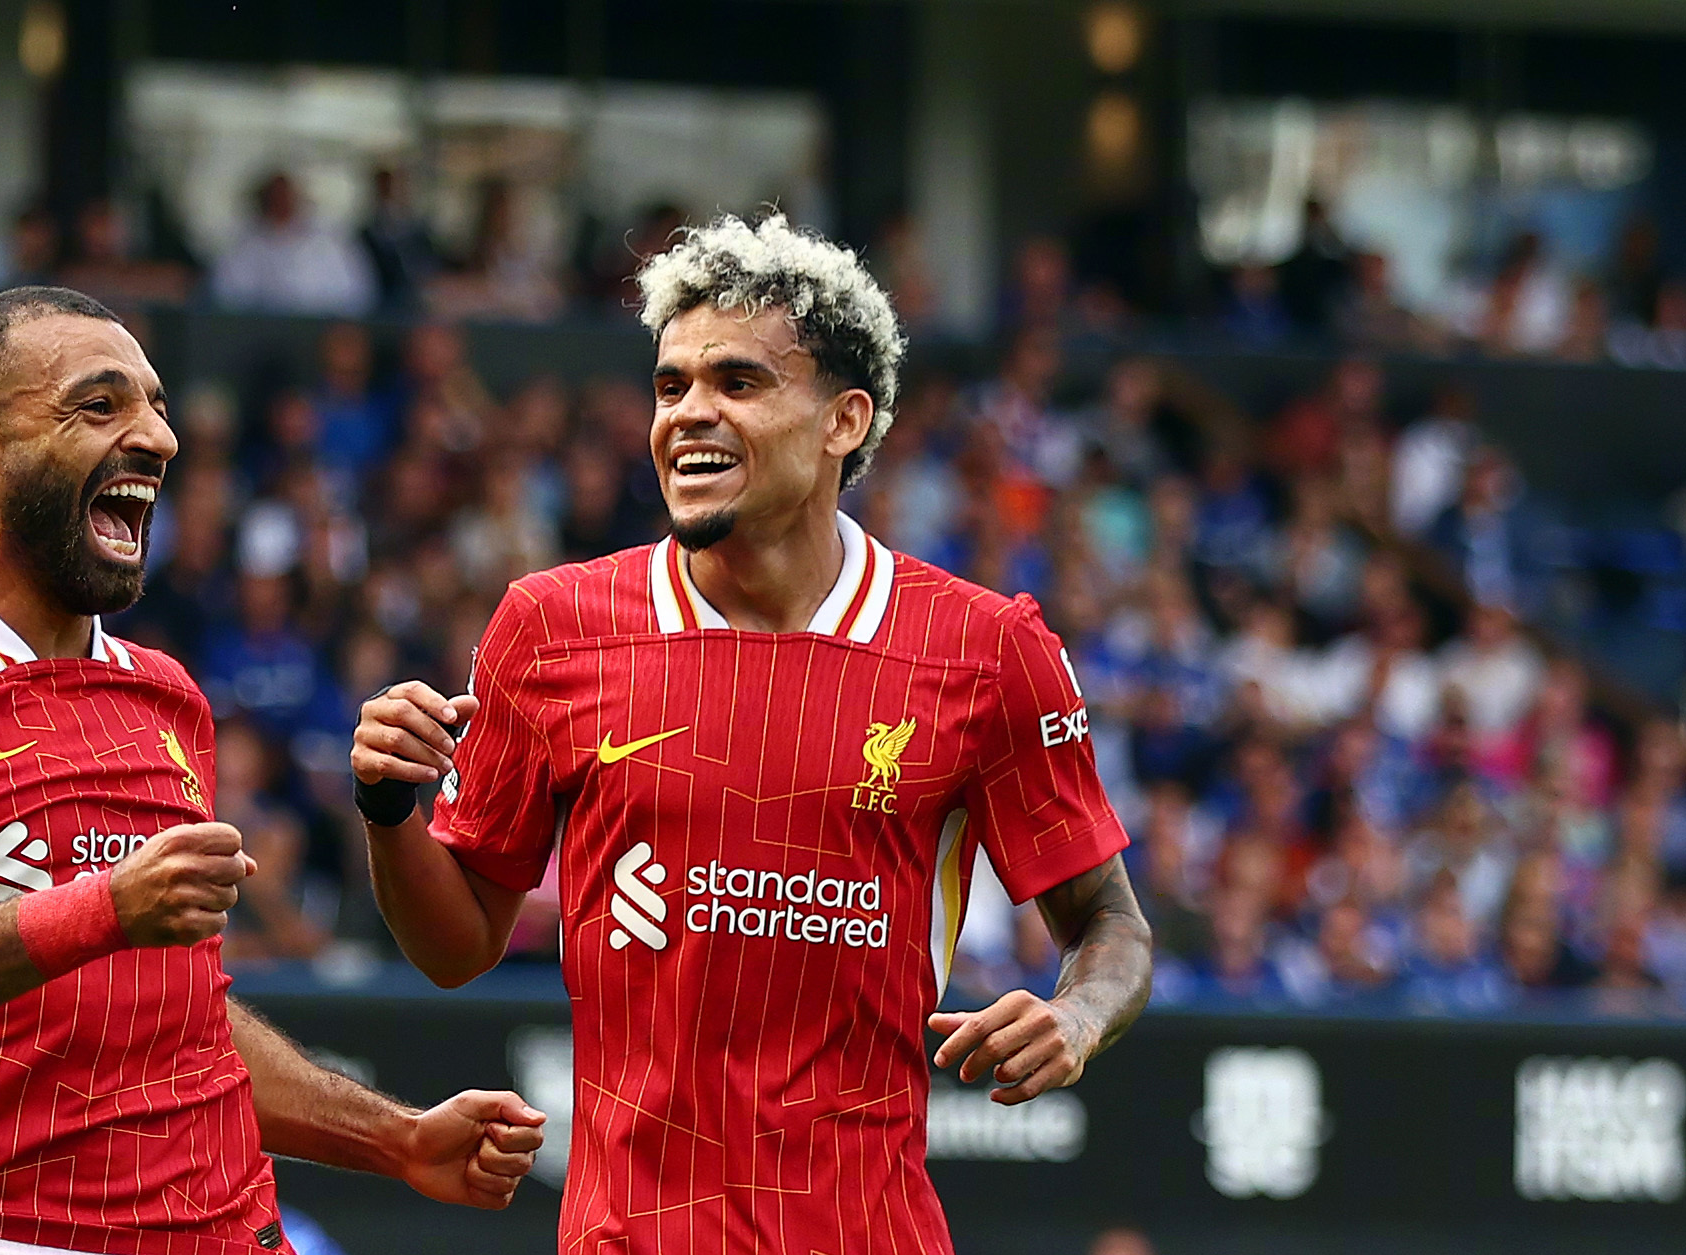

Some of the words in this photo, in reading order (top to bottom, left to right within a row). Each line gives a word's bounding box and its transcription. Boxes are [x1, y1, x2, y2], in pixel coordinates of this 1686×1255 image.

[851, 787, 898, 815] L.F.C.
[687, 859, 880, 911] standard
[686, 897, 889, 948] chartered
